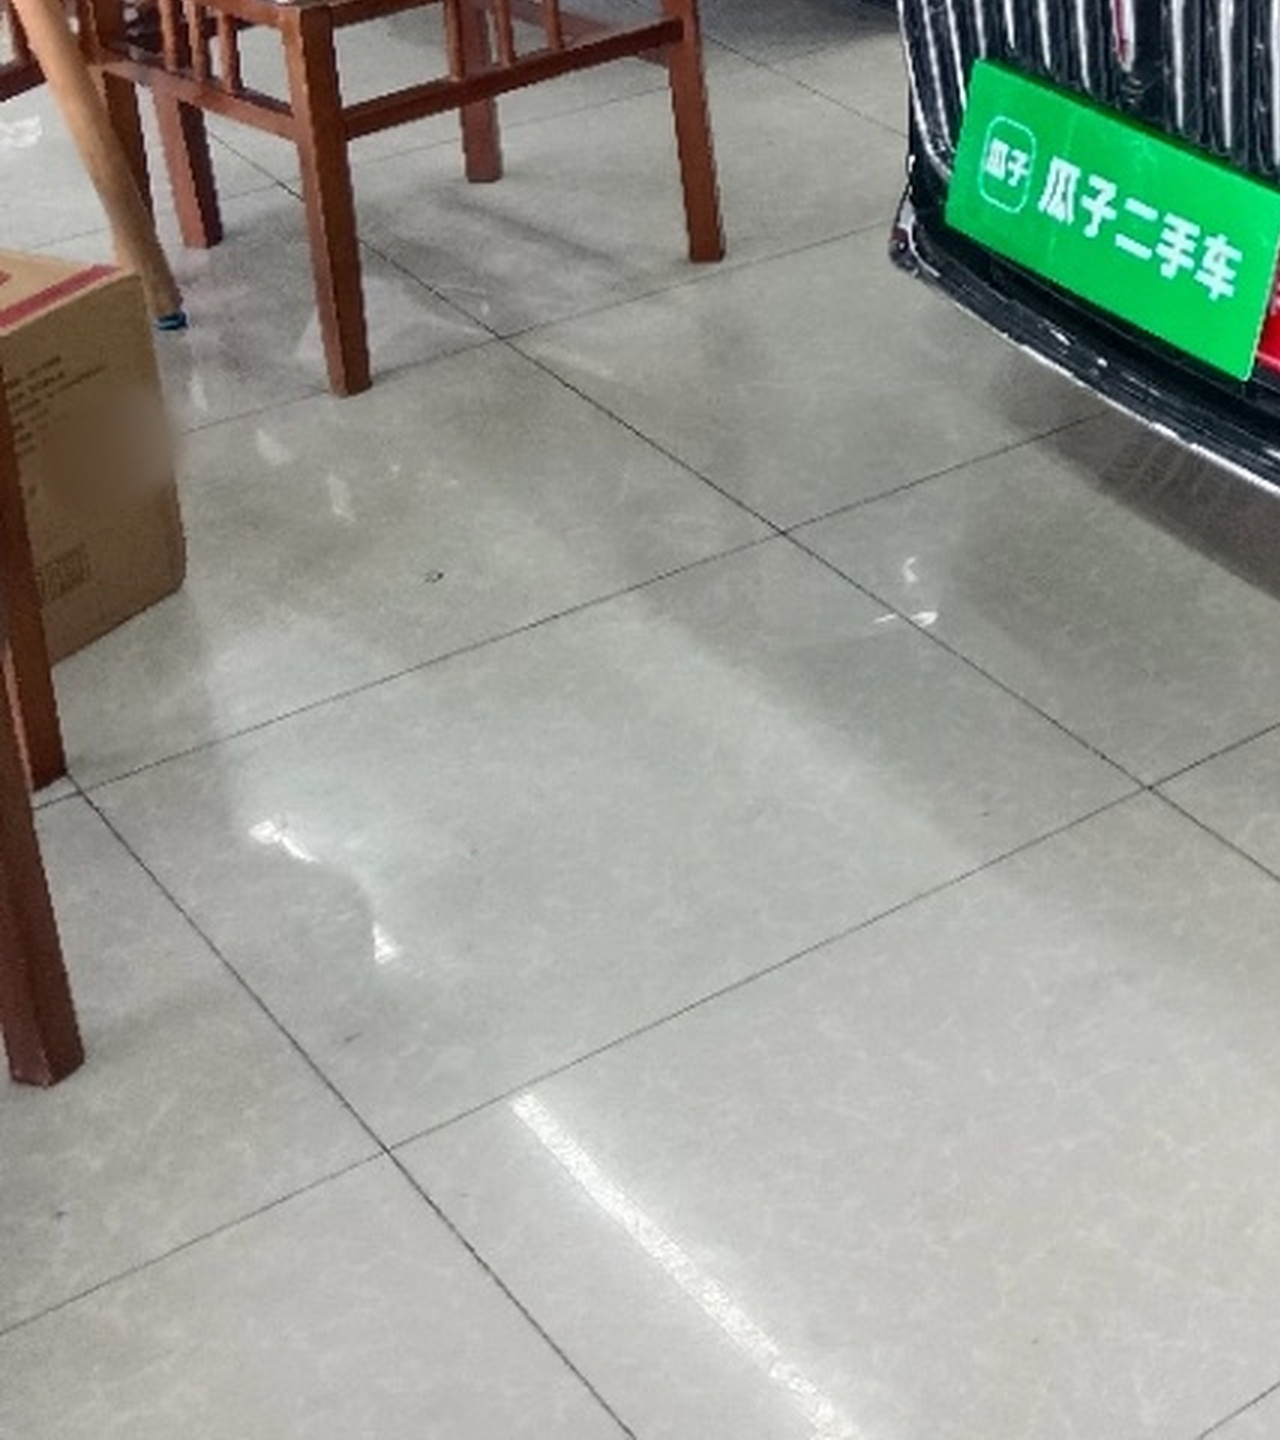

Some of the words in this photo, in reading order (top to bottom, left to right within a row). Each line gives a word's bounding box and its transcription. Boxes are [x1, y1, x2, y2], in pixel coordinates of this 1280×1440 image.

[985, 137, 1031, 187] 瓜子
[1037, 155, 1244, 302] 瓜子二手车
